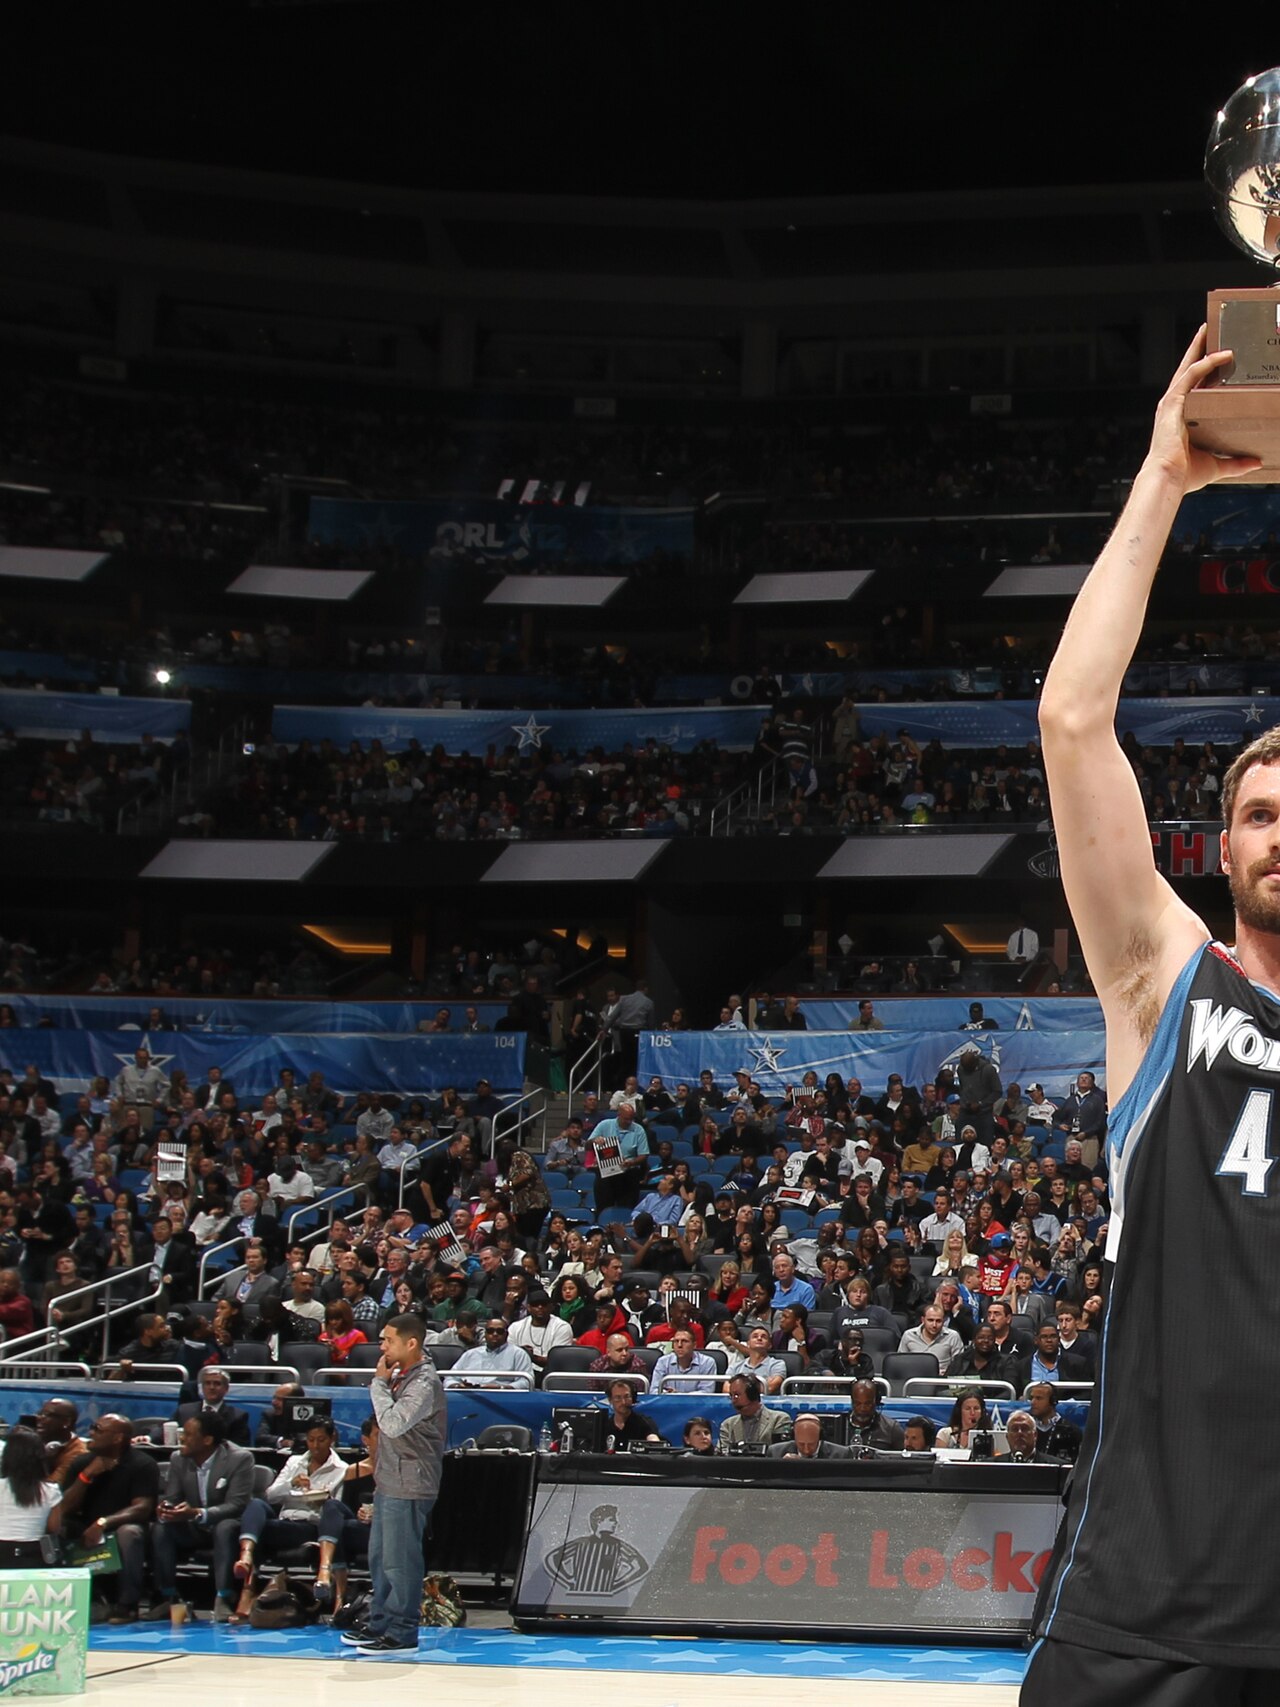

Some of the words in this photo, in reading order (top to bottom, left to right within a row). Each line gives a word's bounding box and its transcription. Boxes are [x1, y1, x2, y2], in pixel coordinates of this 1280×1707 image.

[1262, 364, 1280, 372] NBA
[1246, 372, 1279, 381] Saturday,
[730, 674, 791, 699] OL
[494, 1036, 516, 1048] 104
[650, 1034, 672, 1048] 105
[690, 1526, 840, 1588] Foot
[868, 1529, 1054, 1594] Lock
